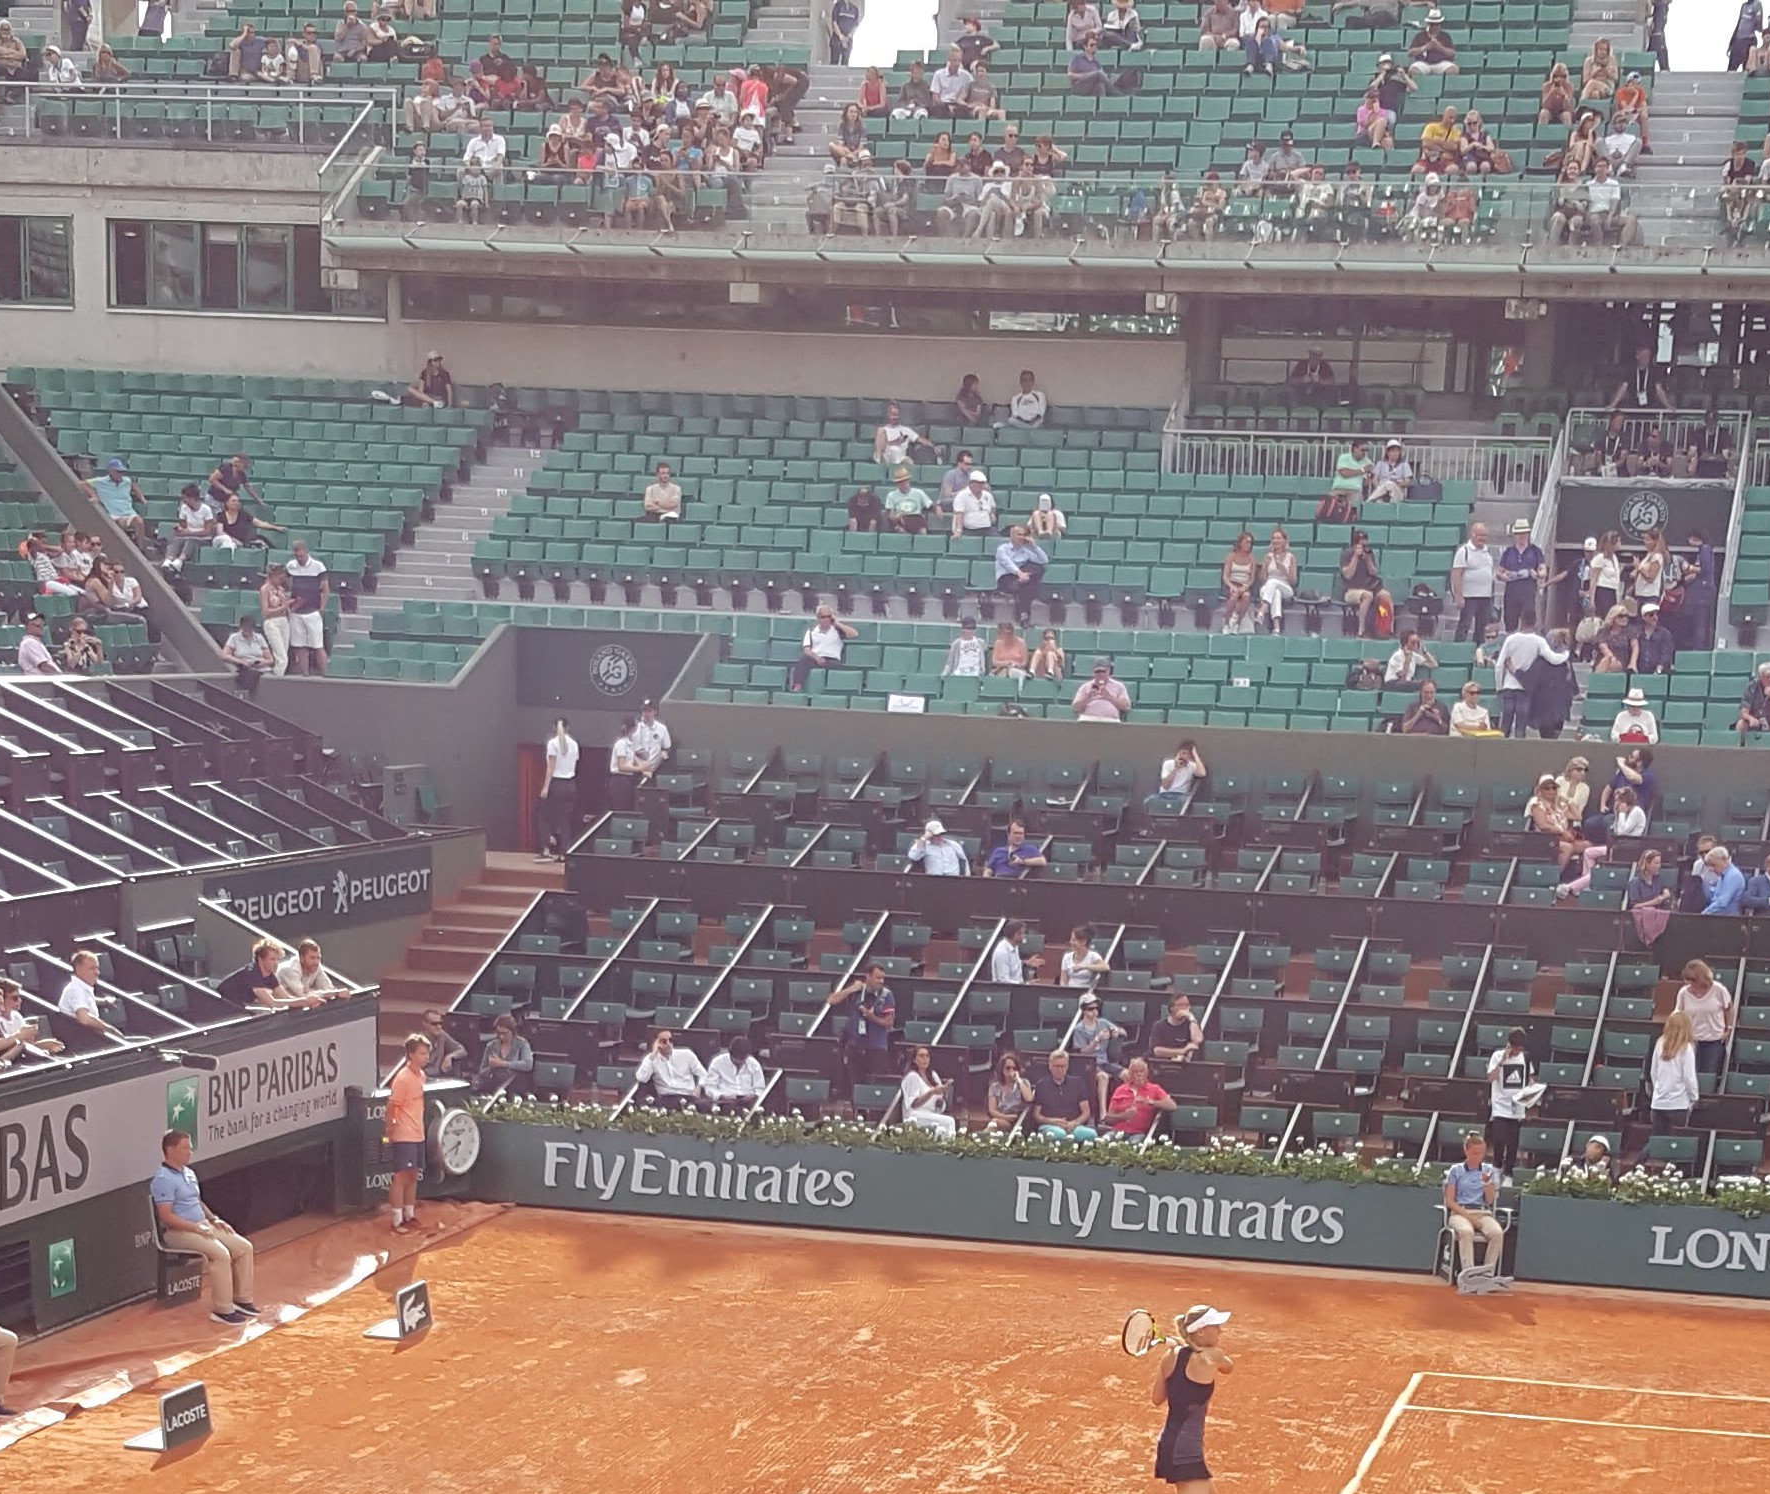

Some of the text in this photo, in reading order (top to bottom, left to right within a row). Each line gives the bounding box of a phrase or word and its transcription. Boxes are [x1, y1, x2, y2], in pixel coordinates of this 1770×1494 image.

[350, 869, 432, 904] PEUGEOT
[209, 1042, 339, 1117] BNP PARIBAS
[209, 1123, 225, 1142] The
[227, 1119, 248, 1137] bank
[250, 1111, 264, 1134] for
[273, 1098, 312, 1122] changing
[313, 1088, 338, 1110] world
[542, 1141, 856, 1208] Fly Emirates
[1013, 1176, 1344, 1244] Fly Emirates
[167, 1275, 201, 1296] LACOSTE
[165, 1399, 209, 1436] LACOSTE
